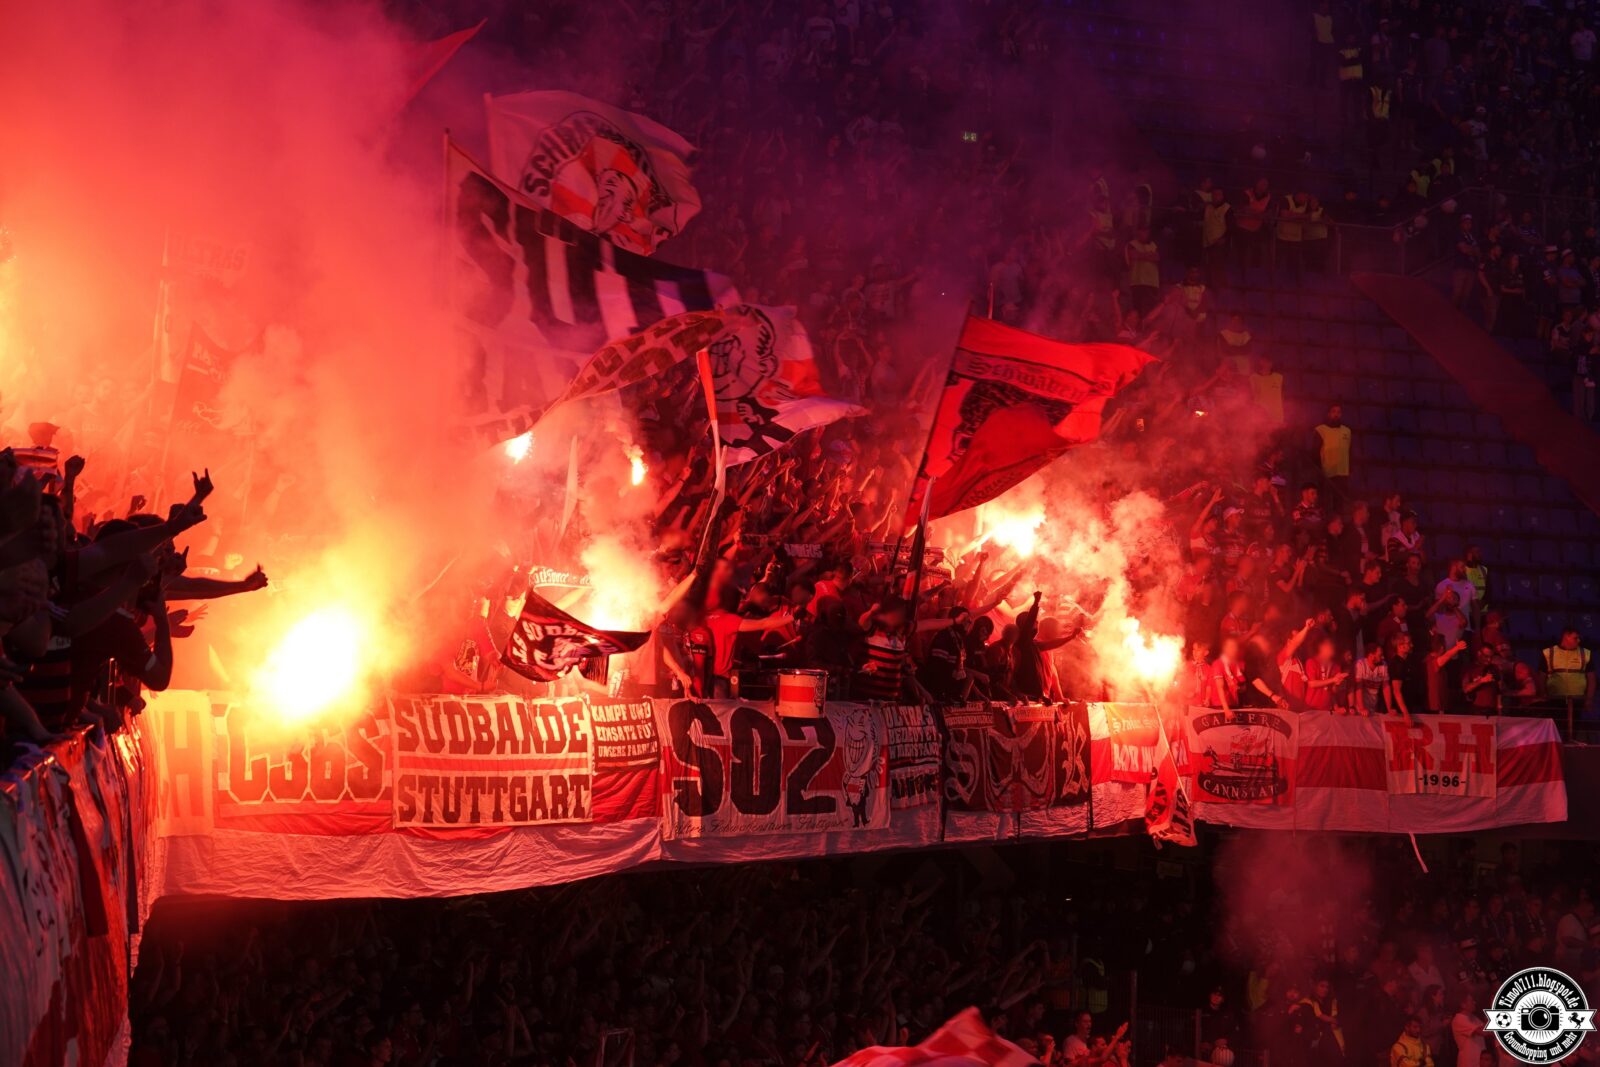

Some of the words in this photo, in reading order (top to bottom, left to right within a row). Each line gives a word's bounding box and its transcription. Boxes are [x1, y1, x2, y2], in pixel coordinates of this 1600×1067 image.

[396, 698, 588, 755] SÜDBANDE
[590, 704, 628, 723] KAMPF
[628, 701, 652, 721] UND
[595, 724, 637, 742] EINSATZ
[1384, 720, 1494, 775] RH
[397, 774, 590, 824] STUTTGART
